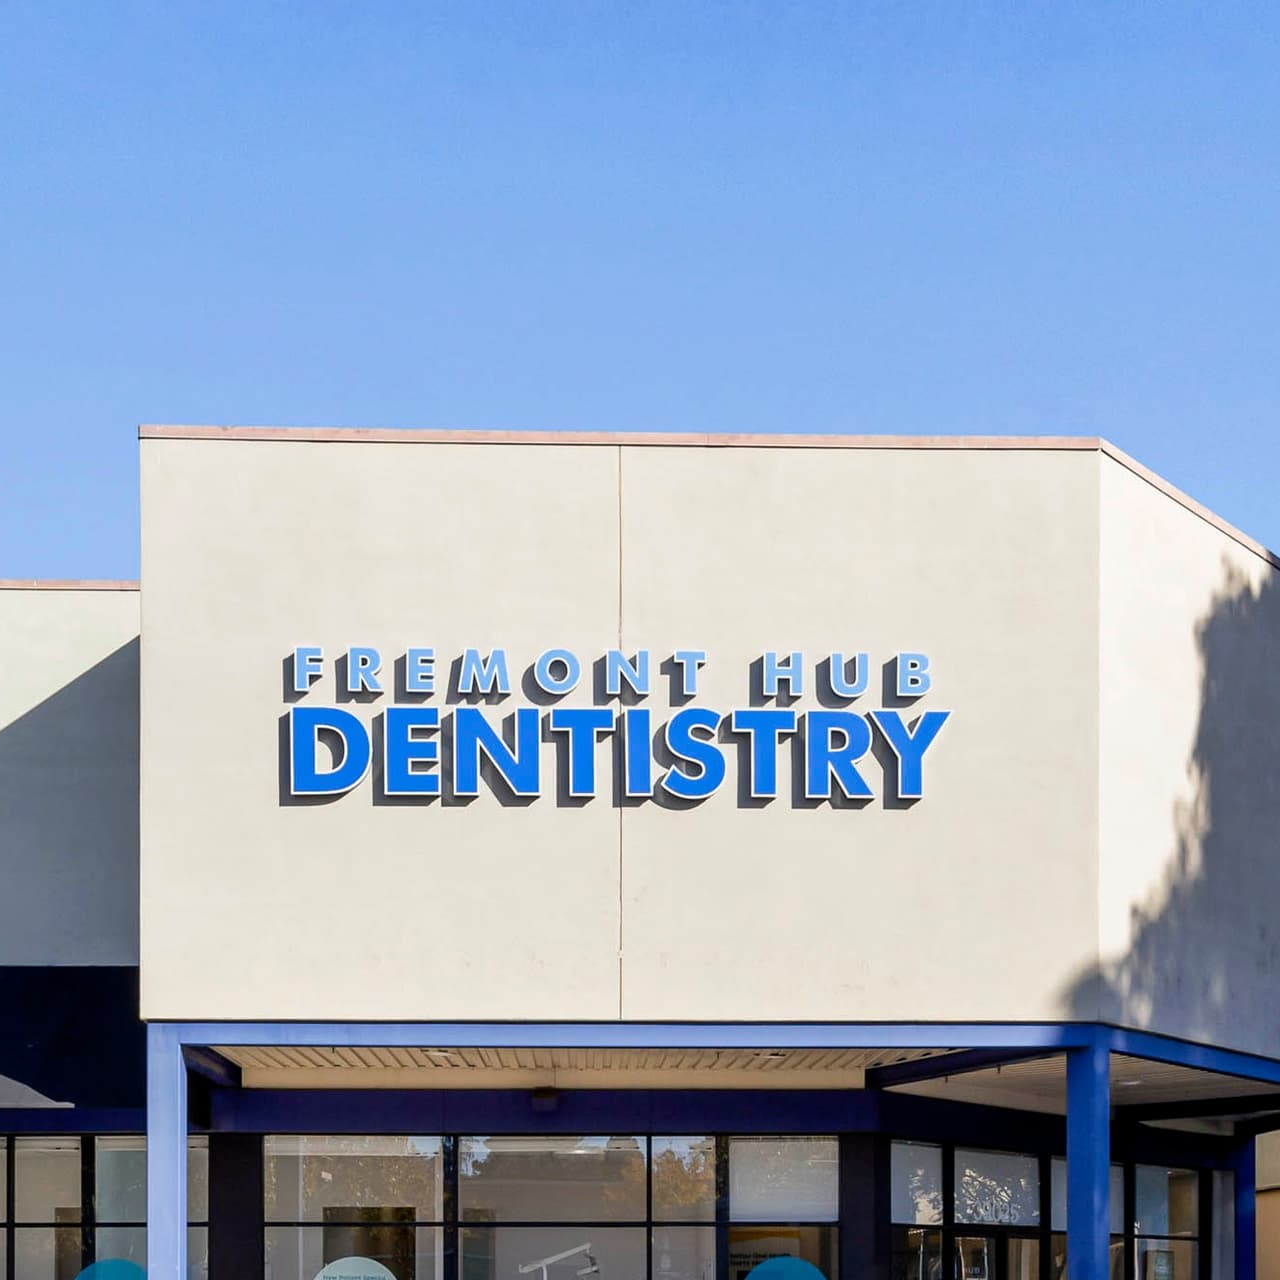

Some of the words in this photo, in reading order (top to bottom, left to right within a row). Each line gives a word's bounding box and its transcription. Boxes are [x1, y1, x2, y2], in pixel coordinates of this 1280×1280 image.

[290, 645, 706, 698] FREMONT
[762, 649, 933, 699] HUB
[286, 705, 954, 800] DENTISTRY
